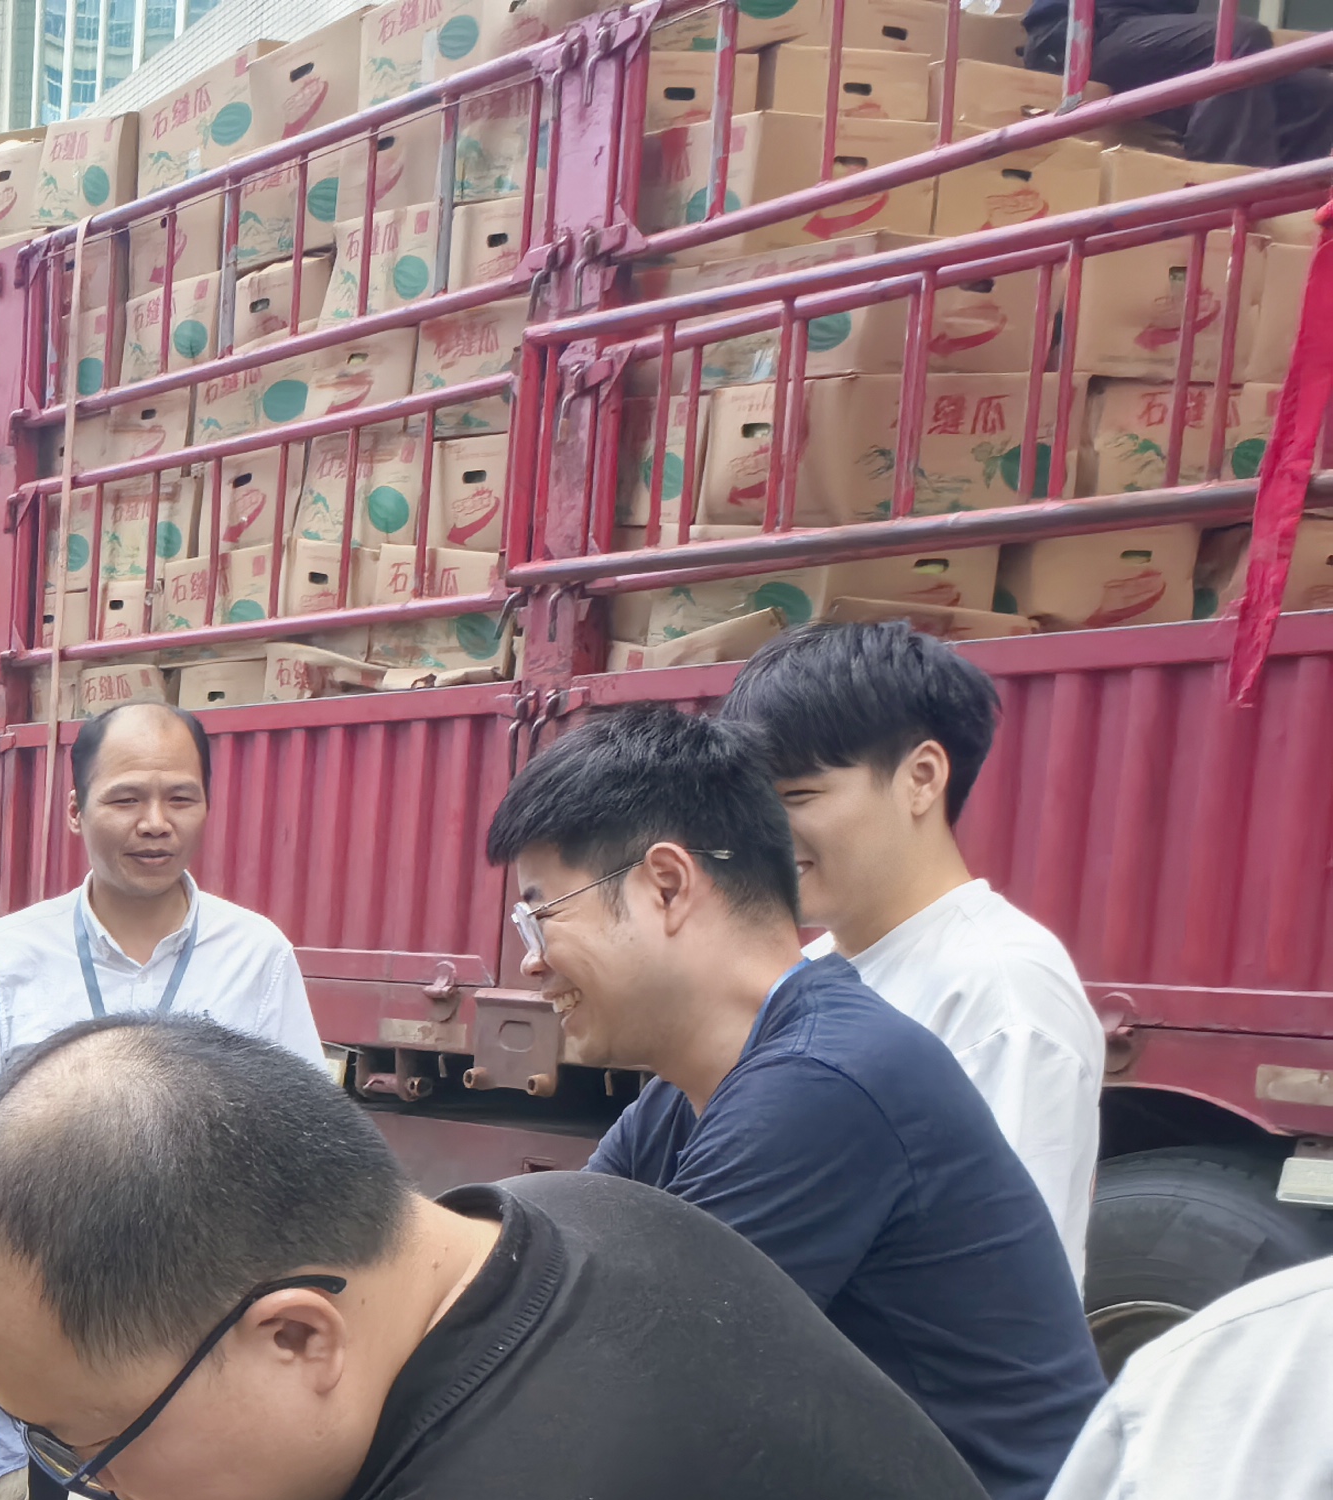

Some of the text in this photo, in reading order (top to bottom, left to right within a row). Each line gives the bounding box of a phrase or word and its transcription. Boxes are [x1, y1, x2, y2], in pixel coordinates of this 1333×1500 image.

[151, 82, 212, 140] 石缝瓜
[388, 562, 460, 596] 石瓜
[84, 674, 133, 703] 石缝瓜
